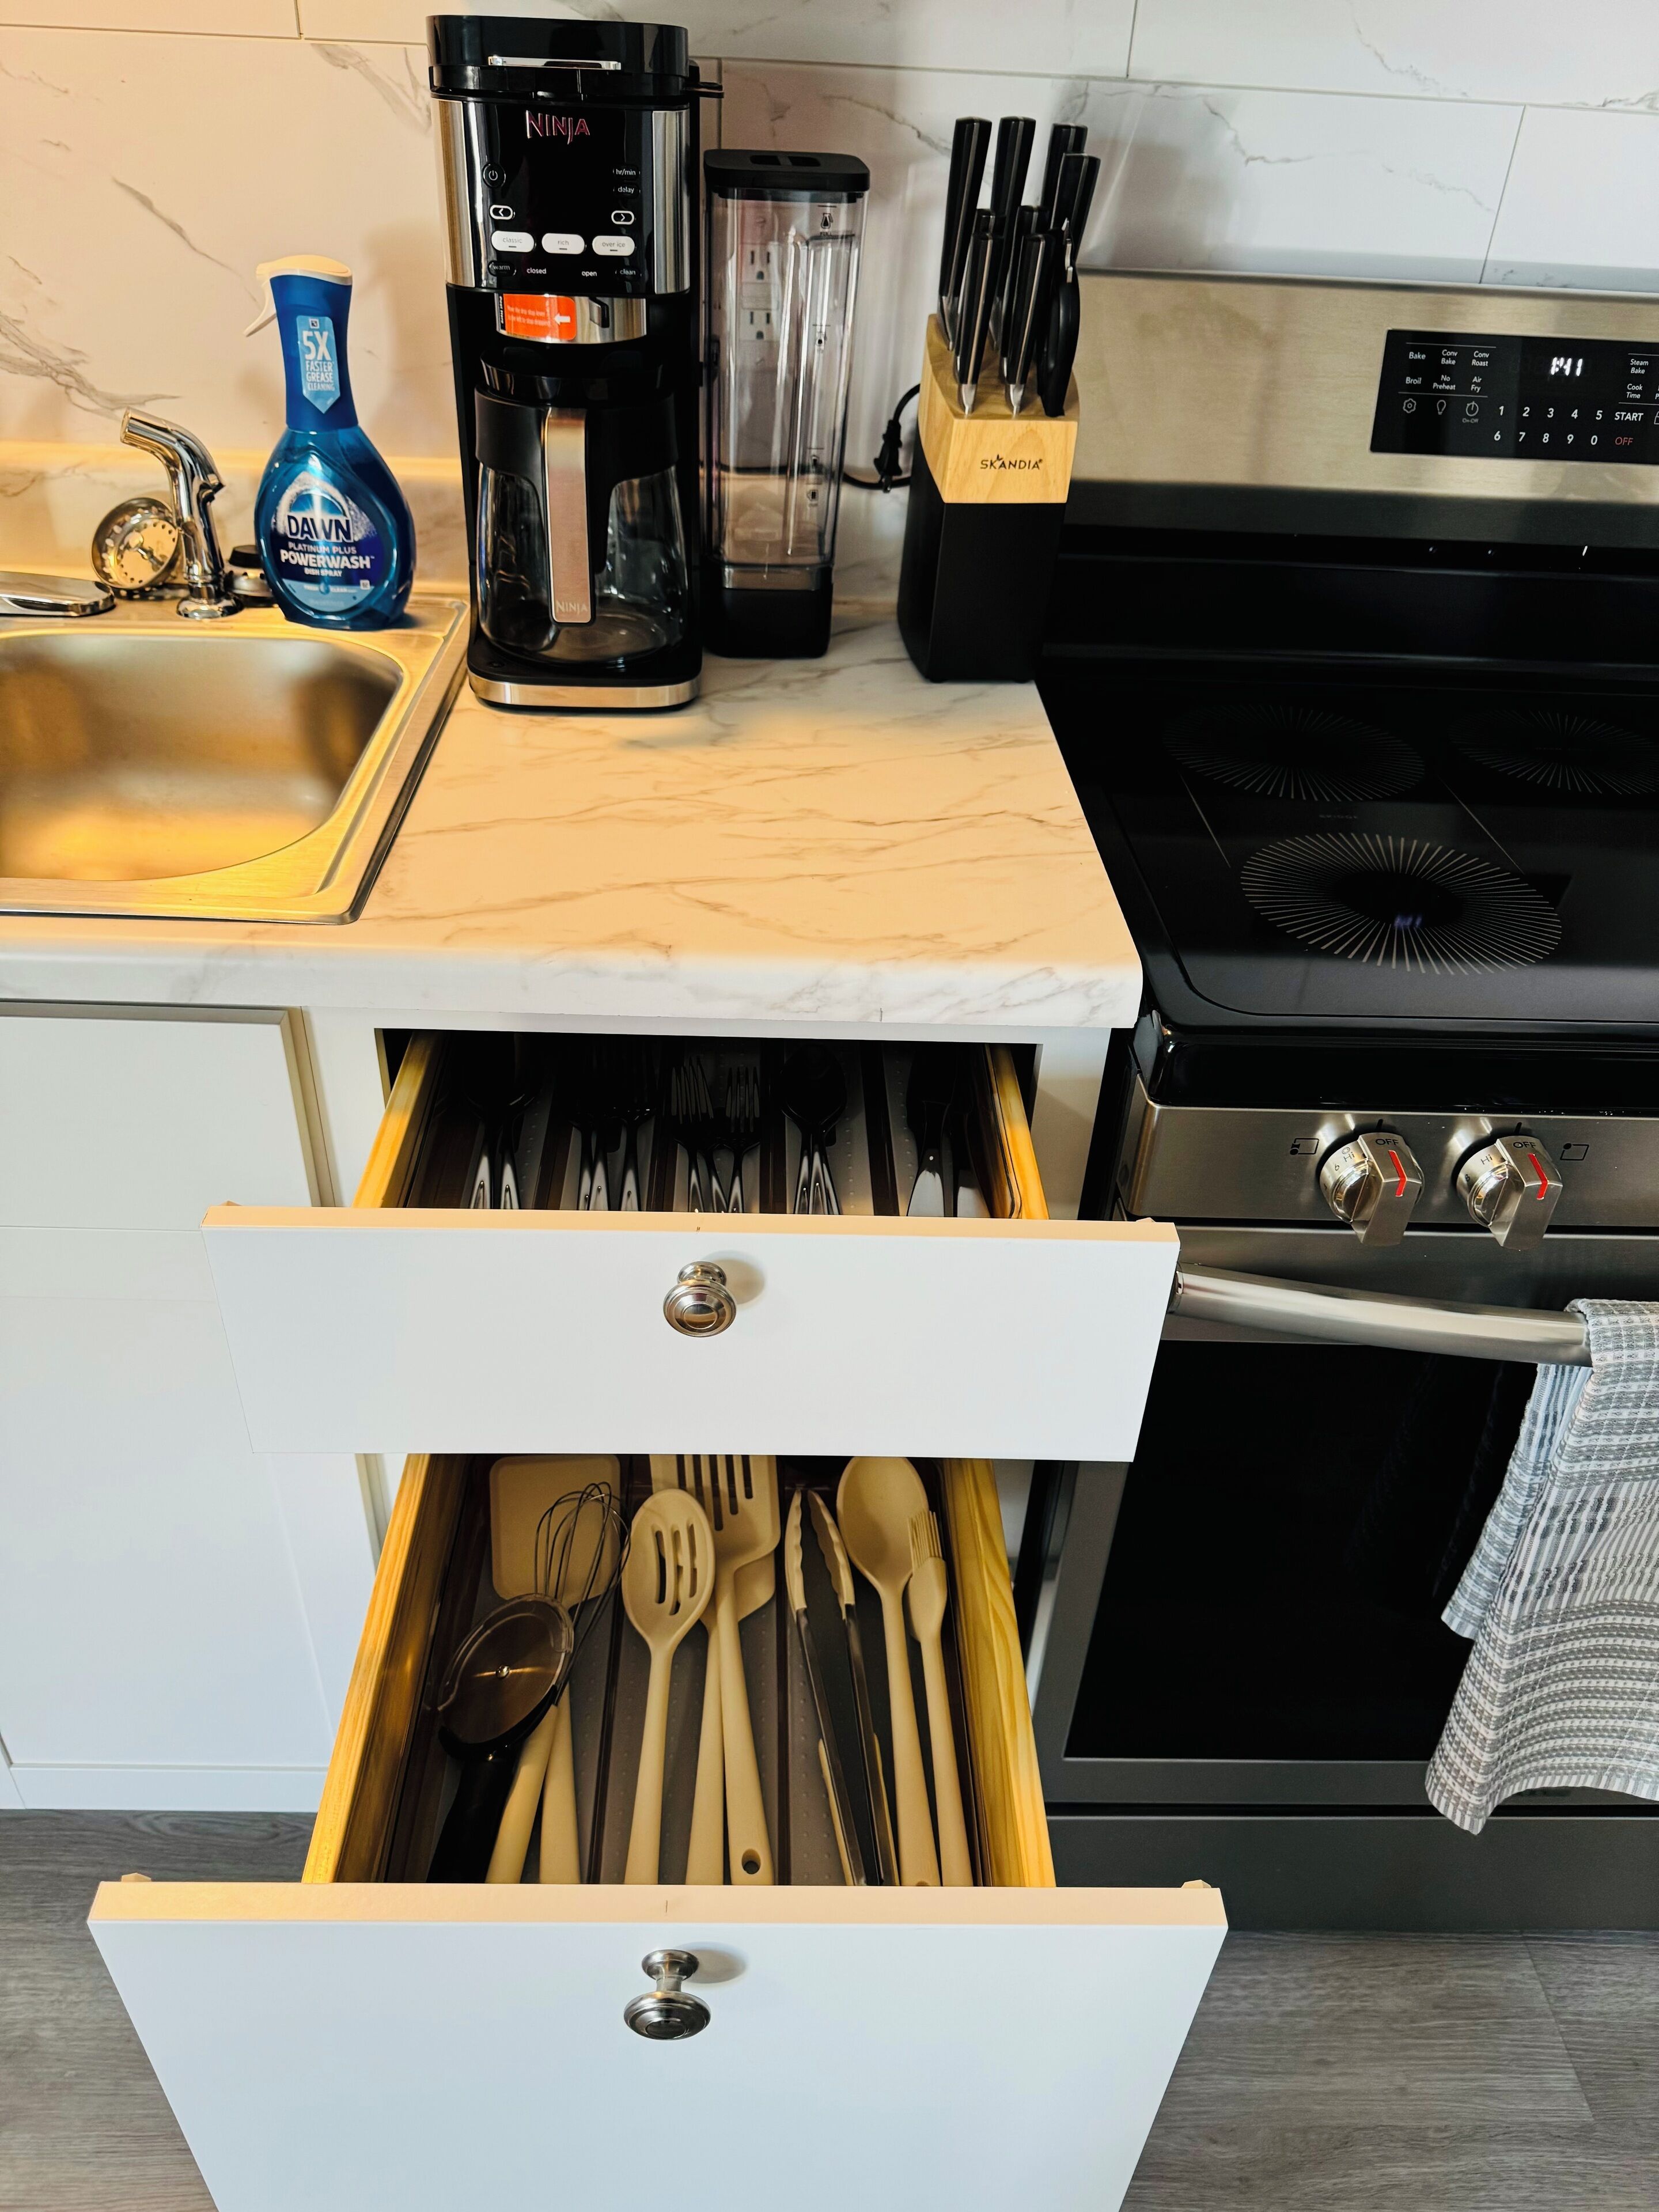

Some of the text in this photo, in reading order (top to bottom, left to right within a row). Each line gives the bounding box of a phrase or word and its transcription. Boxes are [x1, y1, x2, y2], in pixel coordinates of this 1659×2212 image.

[525, 109, 590, 145] NINJA
[618, 186, 634, 194] delay
[302, 330, 332, 361] 5X
[1408, 351, 1426, 360] Bake
[305, 361, 334, 372] FASTER
[1471, 359, 1488, 367] Roast
[306, 372, 334, 383] GREASE
[1406, 376, 1422, 385] Broil
[1433, 382, 1456, 391] Preheat
[1471, 384, 1481, 393] Fry
[1499, 406, 1644, 422] 1 2 3 4 5 START
[1494, 431, 1634, 446] 6 7 8 9 0 OFF
[980, 459, 1040, 470] SKANDIA
[287, 514, 353, 542] DAWN
[288, 541, 357, 555] PLATINUM PLUS
[279, 549, 372, 569] POWERWASH
[304, 567, 343, 577] DISH SPRAY
[556, 599, 588, 615] NINJA
[1343, 1152, 1355, 1162] Hi
[1480, 1154, 1493, 1165] Hi
